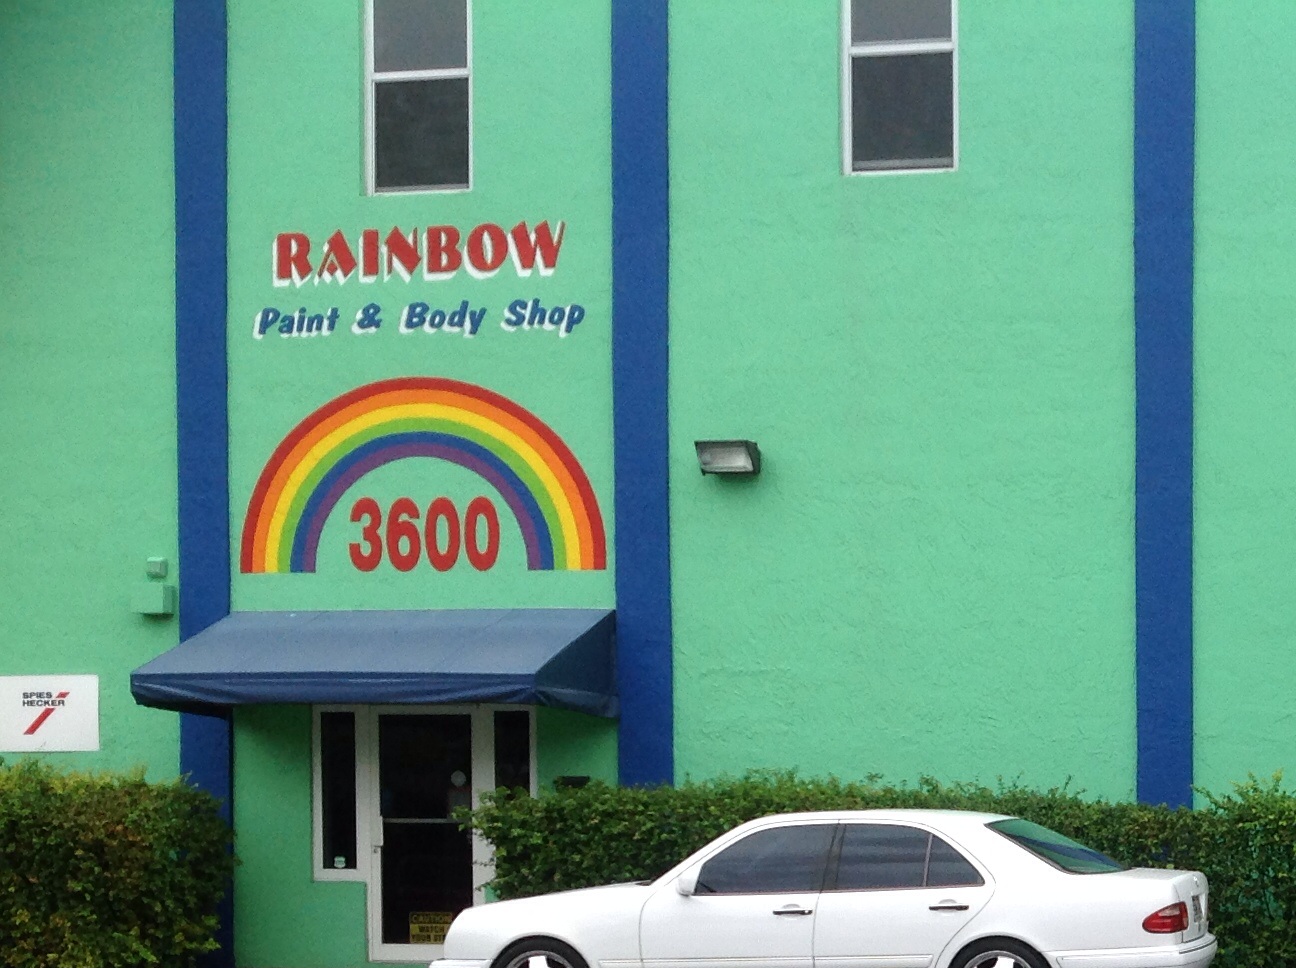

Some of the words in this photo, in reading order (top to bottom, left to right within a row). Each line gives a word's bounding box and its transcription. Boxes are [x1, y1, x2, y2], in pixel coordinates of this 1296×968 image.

[273, 220, 566, 288] RAINBOW
[254, 306, 341, 339] Paint
[352, 302, 382, 334] &
[399, 300, 487, 338] Body
[500, 298, 585, 338] Shop
[348, 496, 501, 573] 3600
[22, 691, 53, 699] SPIES
[22, 699, 65, 707] HECKER
